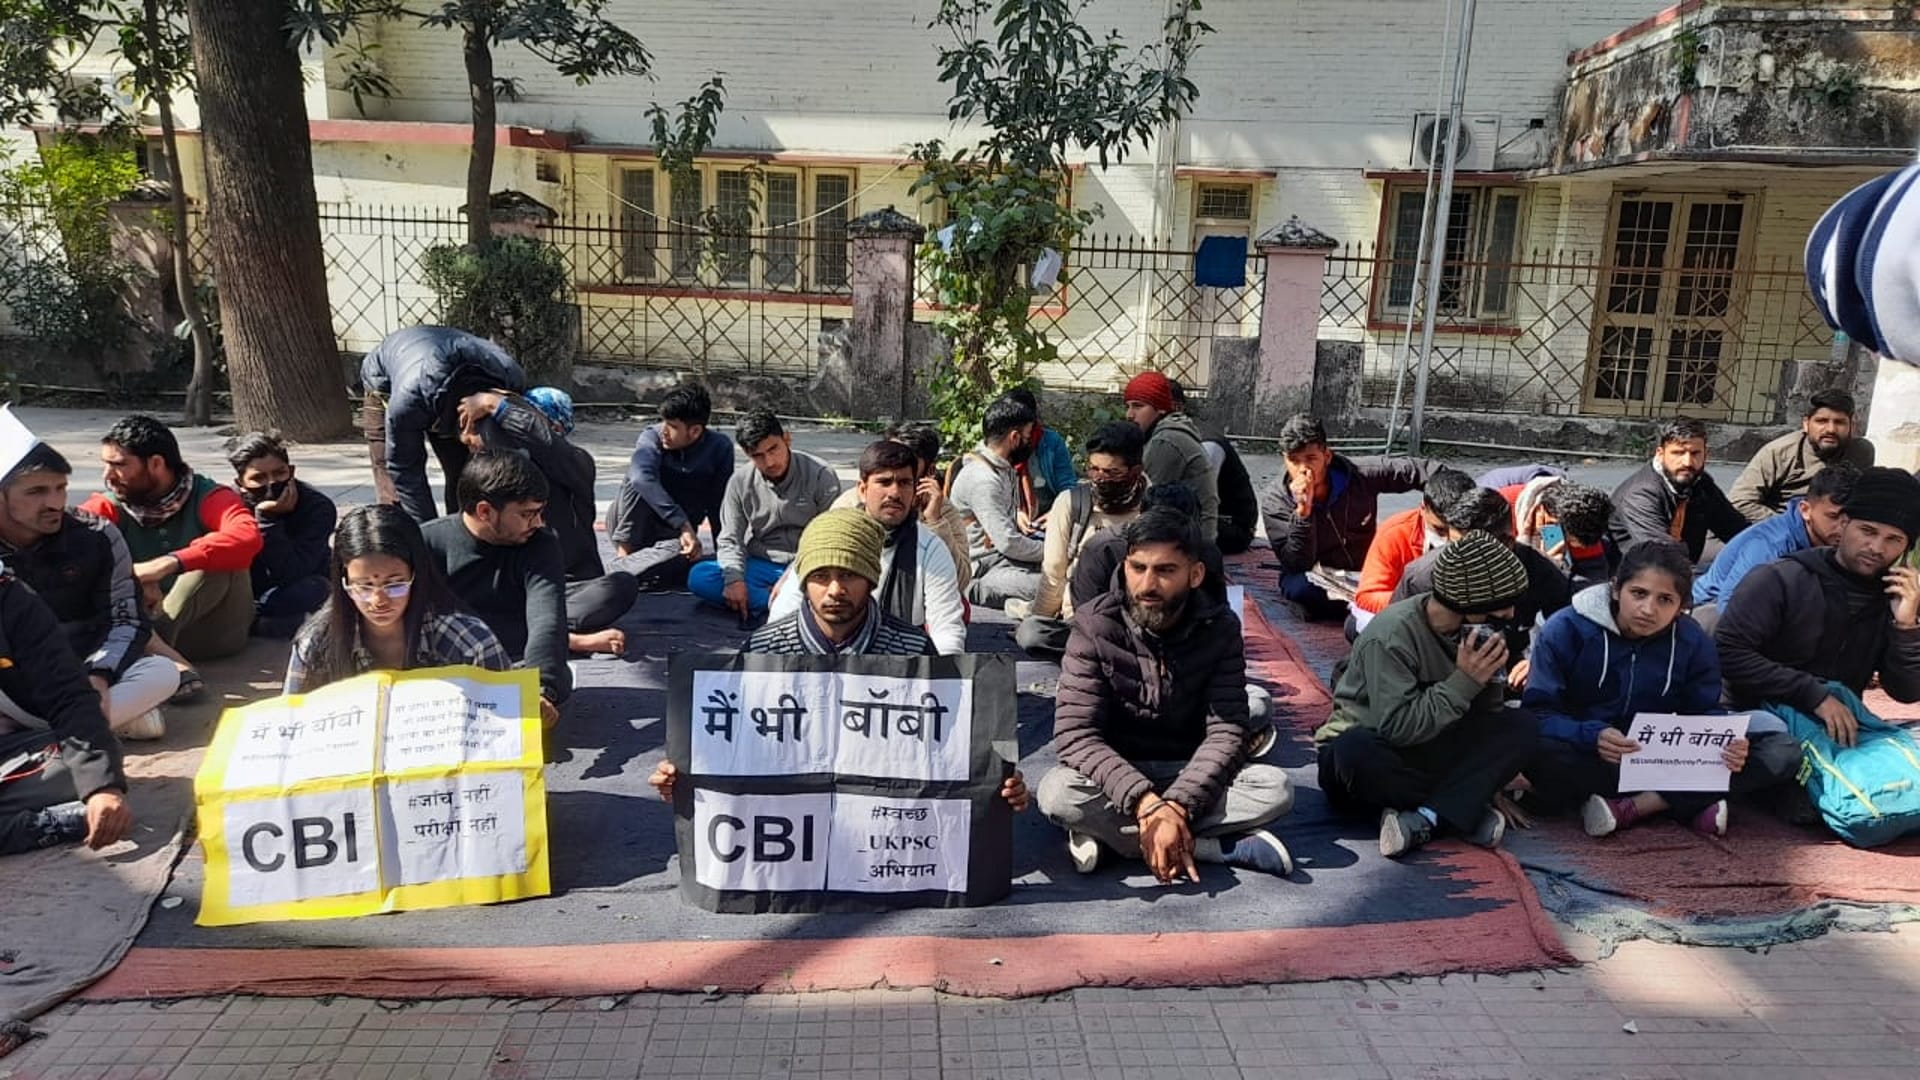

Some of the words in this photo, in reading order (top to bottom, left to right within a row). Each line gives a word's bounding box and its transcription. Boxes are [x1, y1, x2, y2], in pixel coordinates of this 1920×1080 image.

[278, 721, 307, 740] भी
[702, 689, 740, 742] मैं
[750, 693, 808, 742] भी
[839, 687, 949, 742] बॉबी
[1638, 724, 1657, 744] मैं
[1660, 726, 1685, 746] भी
[1688, 728, 1736, 746] बॉबी
[872, 805, 928, 821] #स्वच्छ
[241, 812, 358, 873] CBI
[707, 814, 814, 863] CBI
